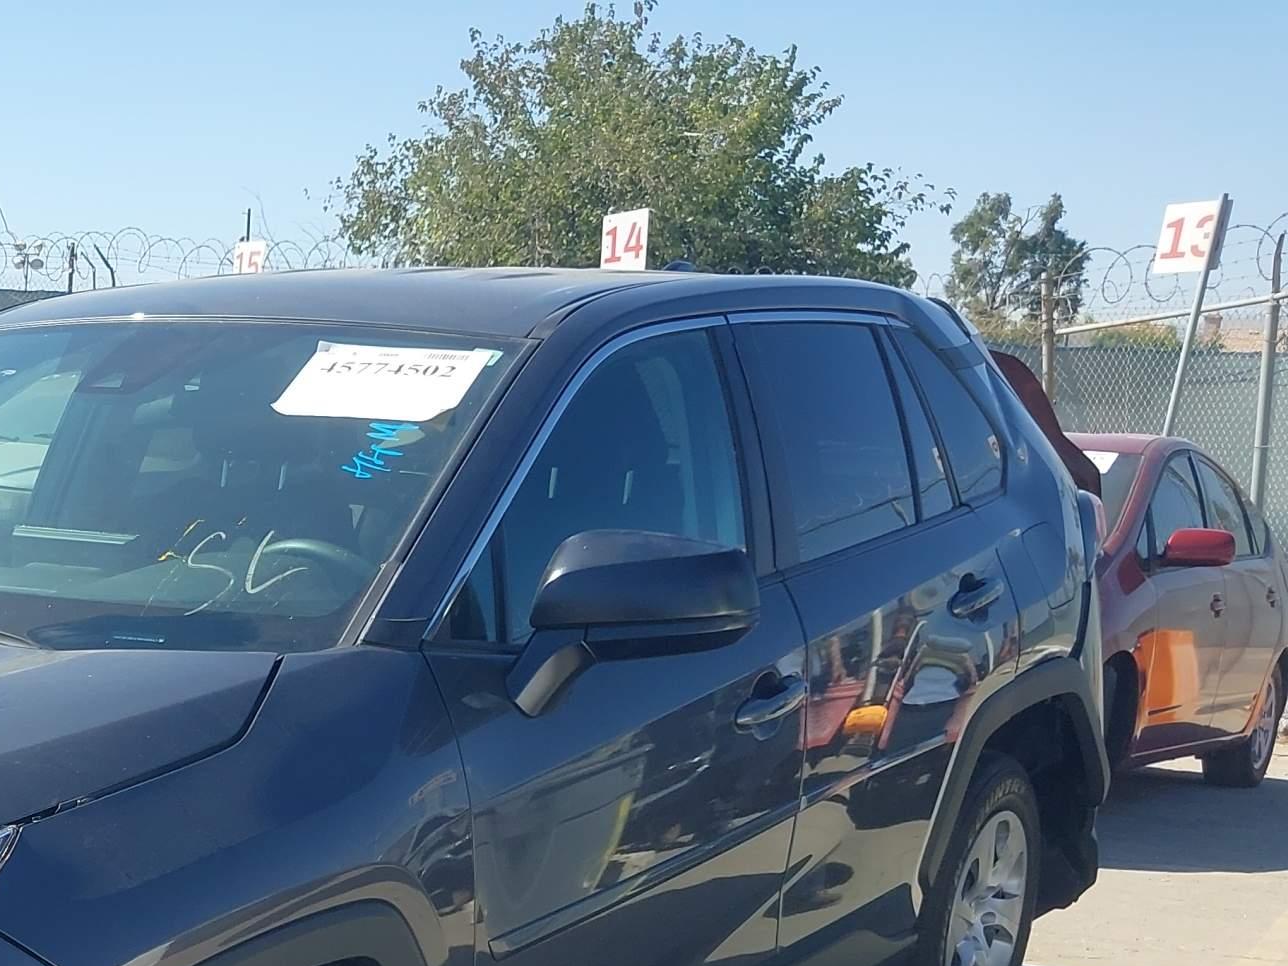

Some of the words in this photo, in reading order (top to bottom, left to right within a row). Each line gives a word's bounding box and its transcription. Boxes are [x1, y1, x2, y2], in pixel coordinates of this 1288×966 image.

[604, 221, 644, 264] 14
[236, 250, 262, 274] 15
[319, 361, 457, 378] 45774502
